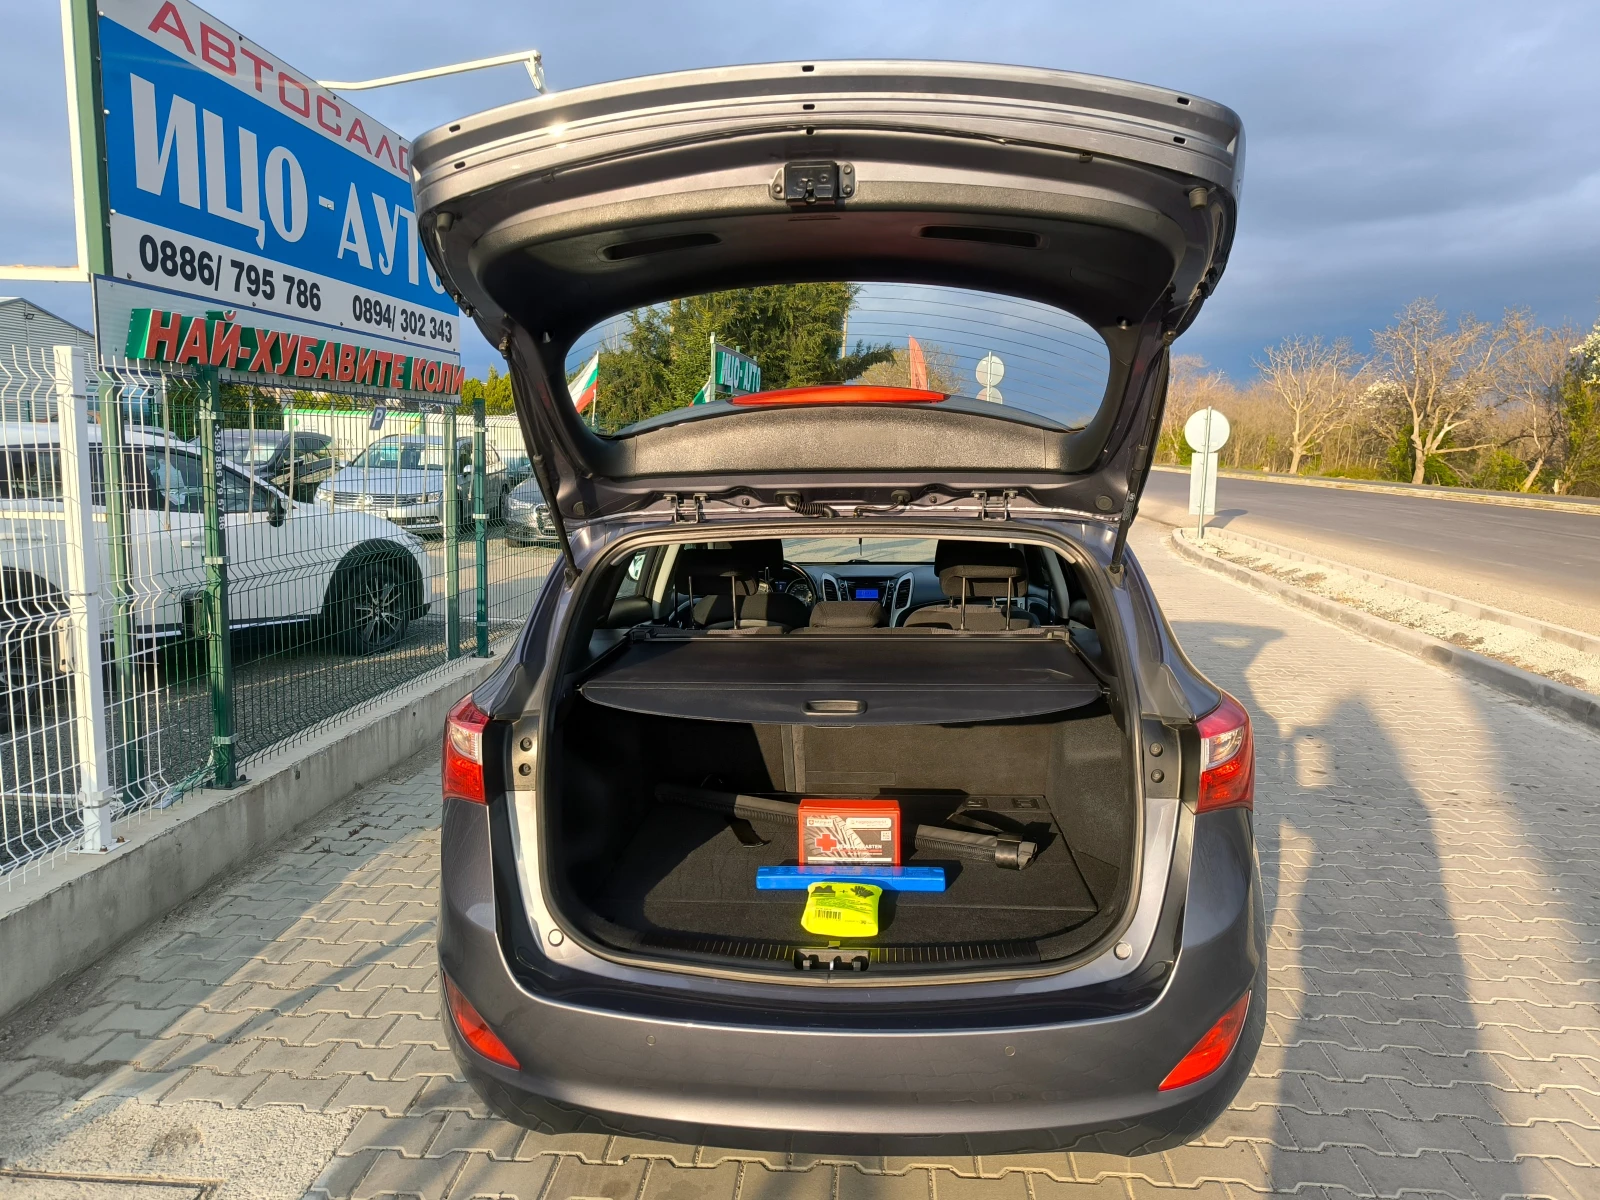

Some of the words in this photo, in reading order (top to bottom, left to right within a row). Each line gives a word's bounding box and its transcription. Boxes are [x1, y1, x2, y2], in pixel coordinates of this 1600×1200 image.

[139, 234, 222, 291] 0886/
[230, 259, 275, 300] 795
[283, 274, 321, 312] 786
[352, 294, 396, 332] 0894/
[400, 308, 426, 337] 302
[429, 316, 452, 343] 343
[144, 309, 407, 389] НАЙ-ХУБАВИТЕ
[410, 357, 465, 395] КОЛИ
[215, 456, 223, 477] 886
[216, 480, 224, 495] 79
[217, 499, 225, 512] 57
[218, 516, 226, 530] 86
